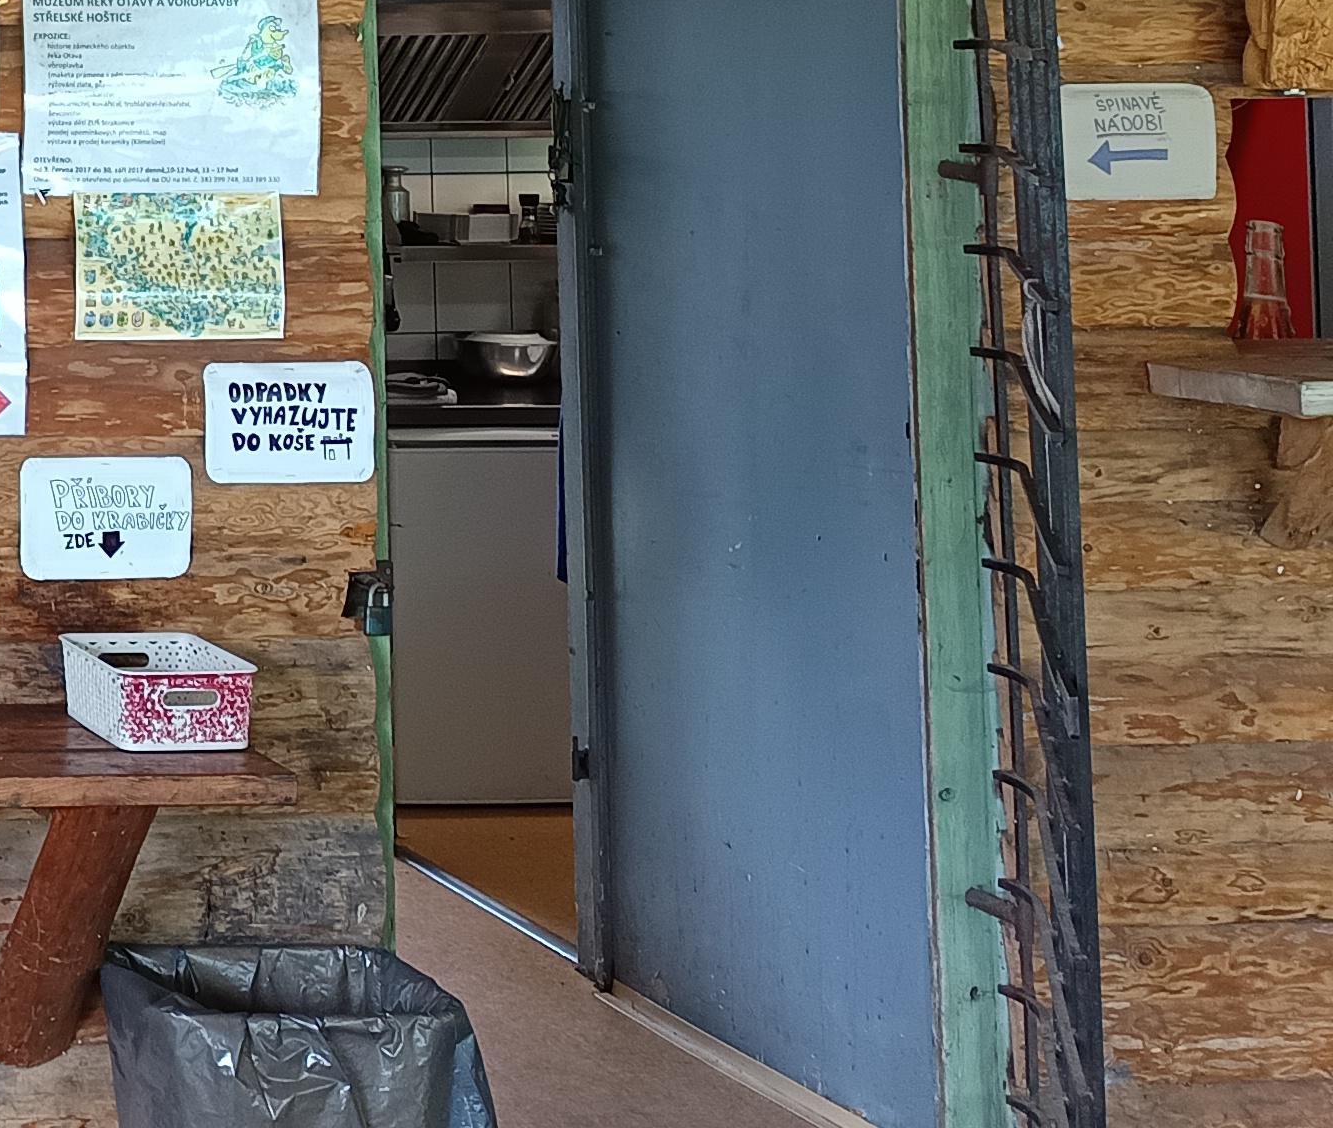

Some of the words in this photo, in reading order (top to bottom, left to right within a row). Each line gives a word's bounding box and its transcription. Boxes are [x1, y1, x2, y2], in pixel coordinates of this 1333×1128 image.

[33, 10, 83, 22] STŘELSKÉ
[87, 11, 132, 22] HOŠTICE
[1094, 91, 1164, 112] ŠPINAVÉ
[1094, 110, 1167, 133] NÁDOBÍ
[228, 382, 327, 404] ODPADKY
[231, 405, 358, 432] VYHAZUJTE
[232, 433, 260, 452] DO
[269, 427, 315, 452] KOŠE
[49, 477, 155, 509] PŘÍBORY
[55, 510, 83, 532] DO
[93, 504, 190, 531] KRABIČKY
[64, 532, 95, 550] ZDE
